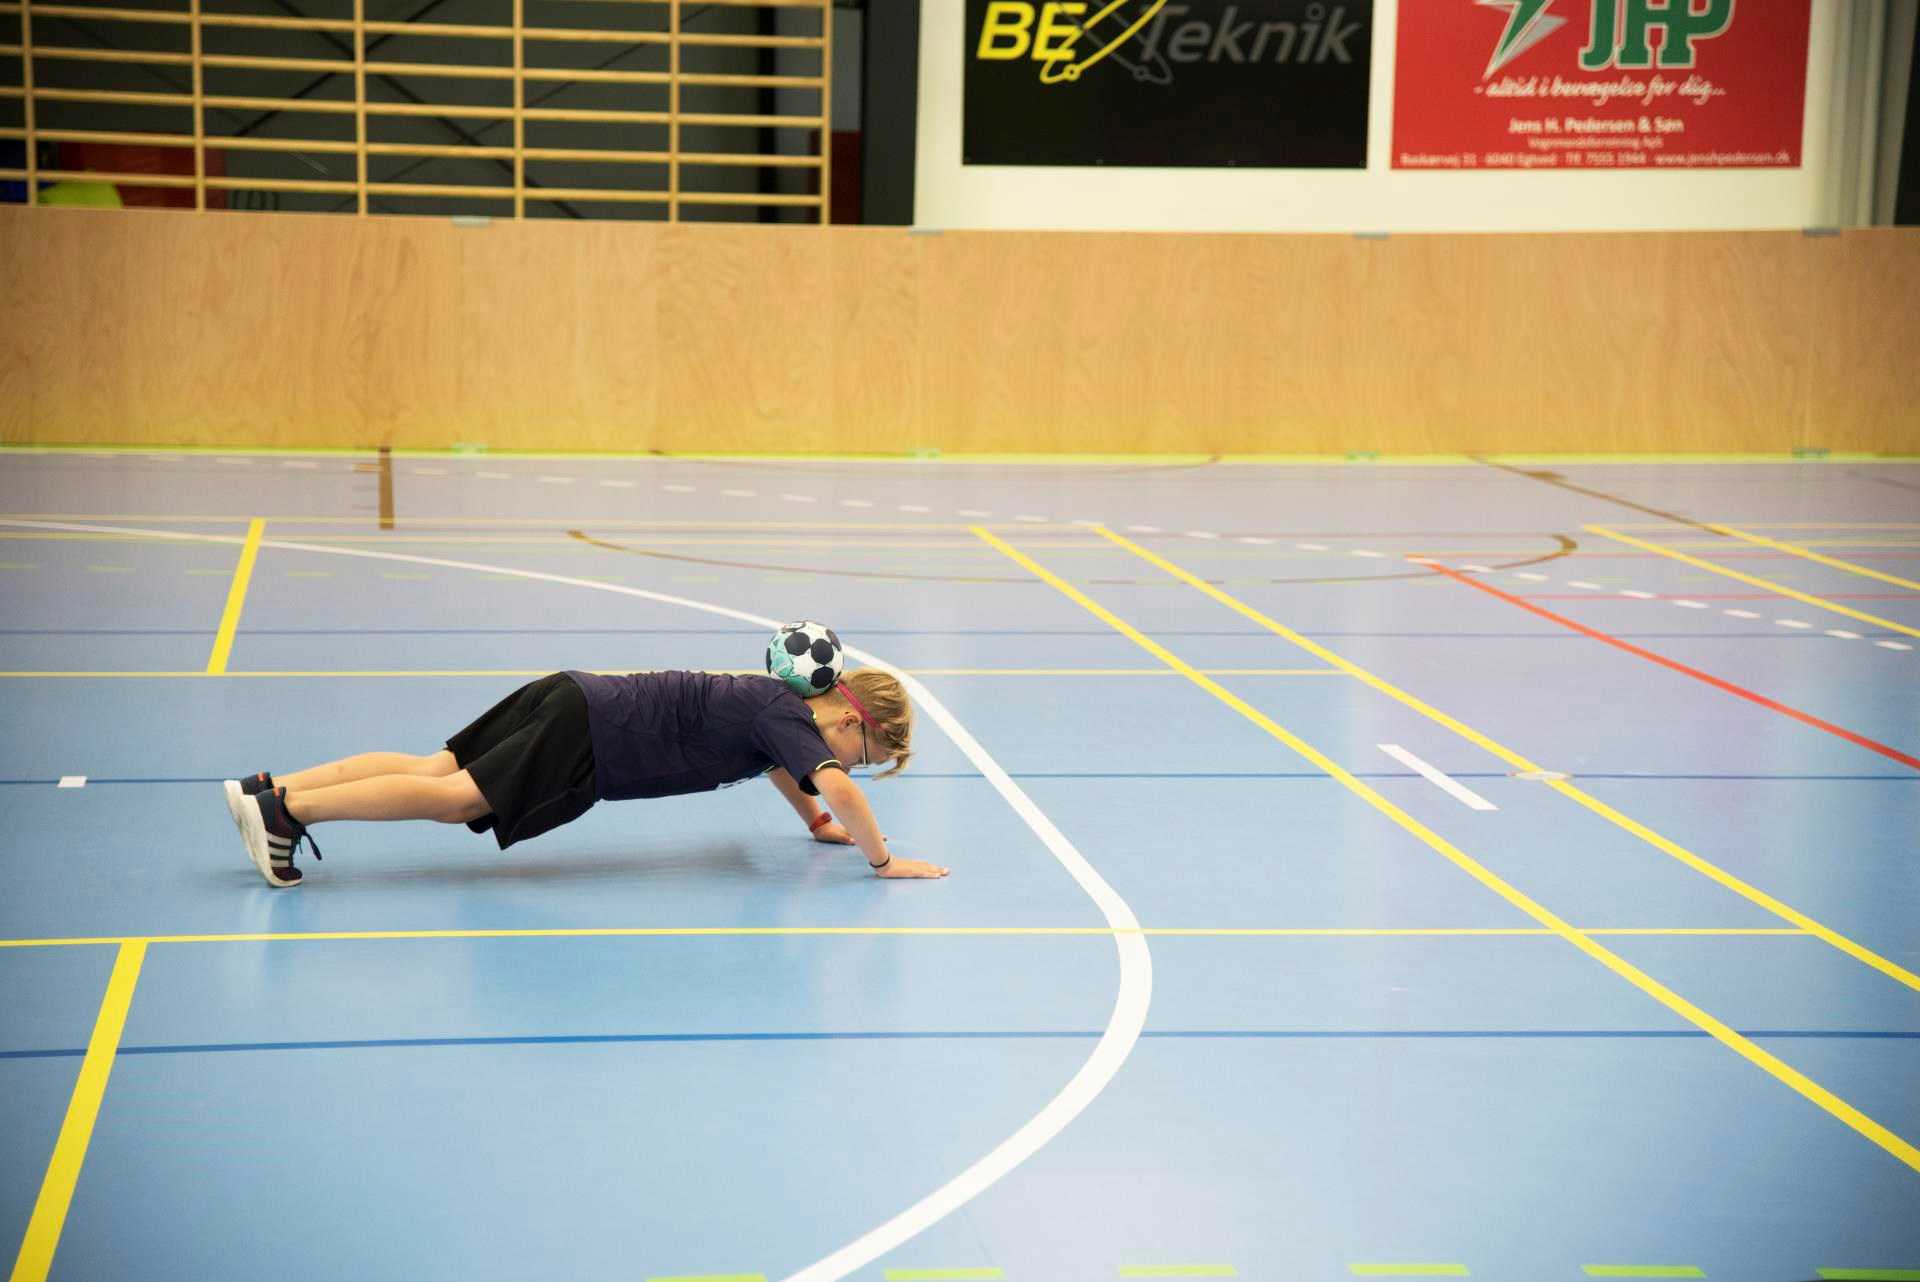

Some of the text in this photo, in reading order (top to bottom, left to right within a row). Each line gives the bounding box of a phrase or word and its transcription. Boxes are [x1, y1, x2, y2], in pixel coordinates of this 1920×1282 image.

[976, 2, 1362, 65] BE Teknik
[1486, 75, 1538, 97] altid
[1539, 76, 1550, 97] i
[1551, 75, 1645, 106] bevægelse
[1641, 74, 1677, 106] for
[1508, 116, 1684, 134] Jens H. Pedersen & Søn
